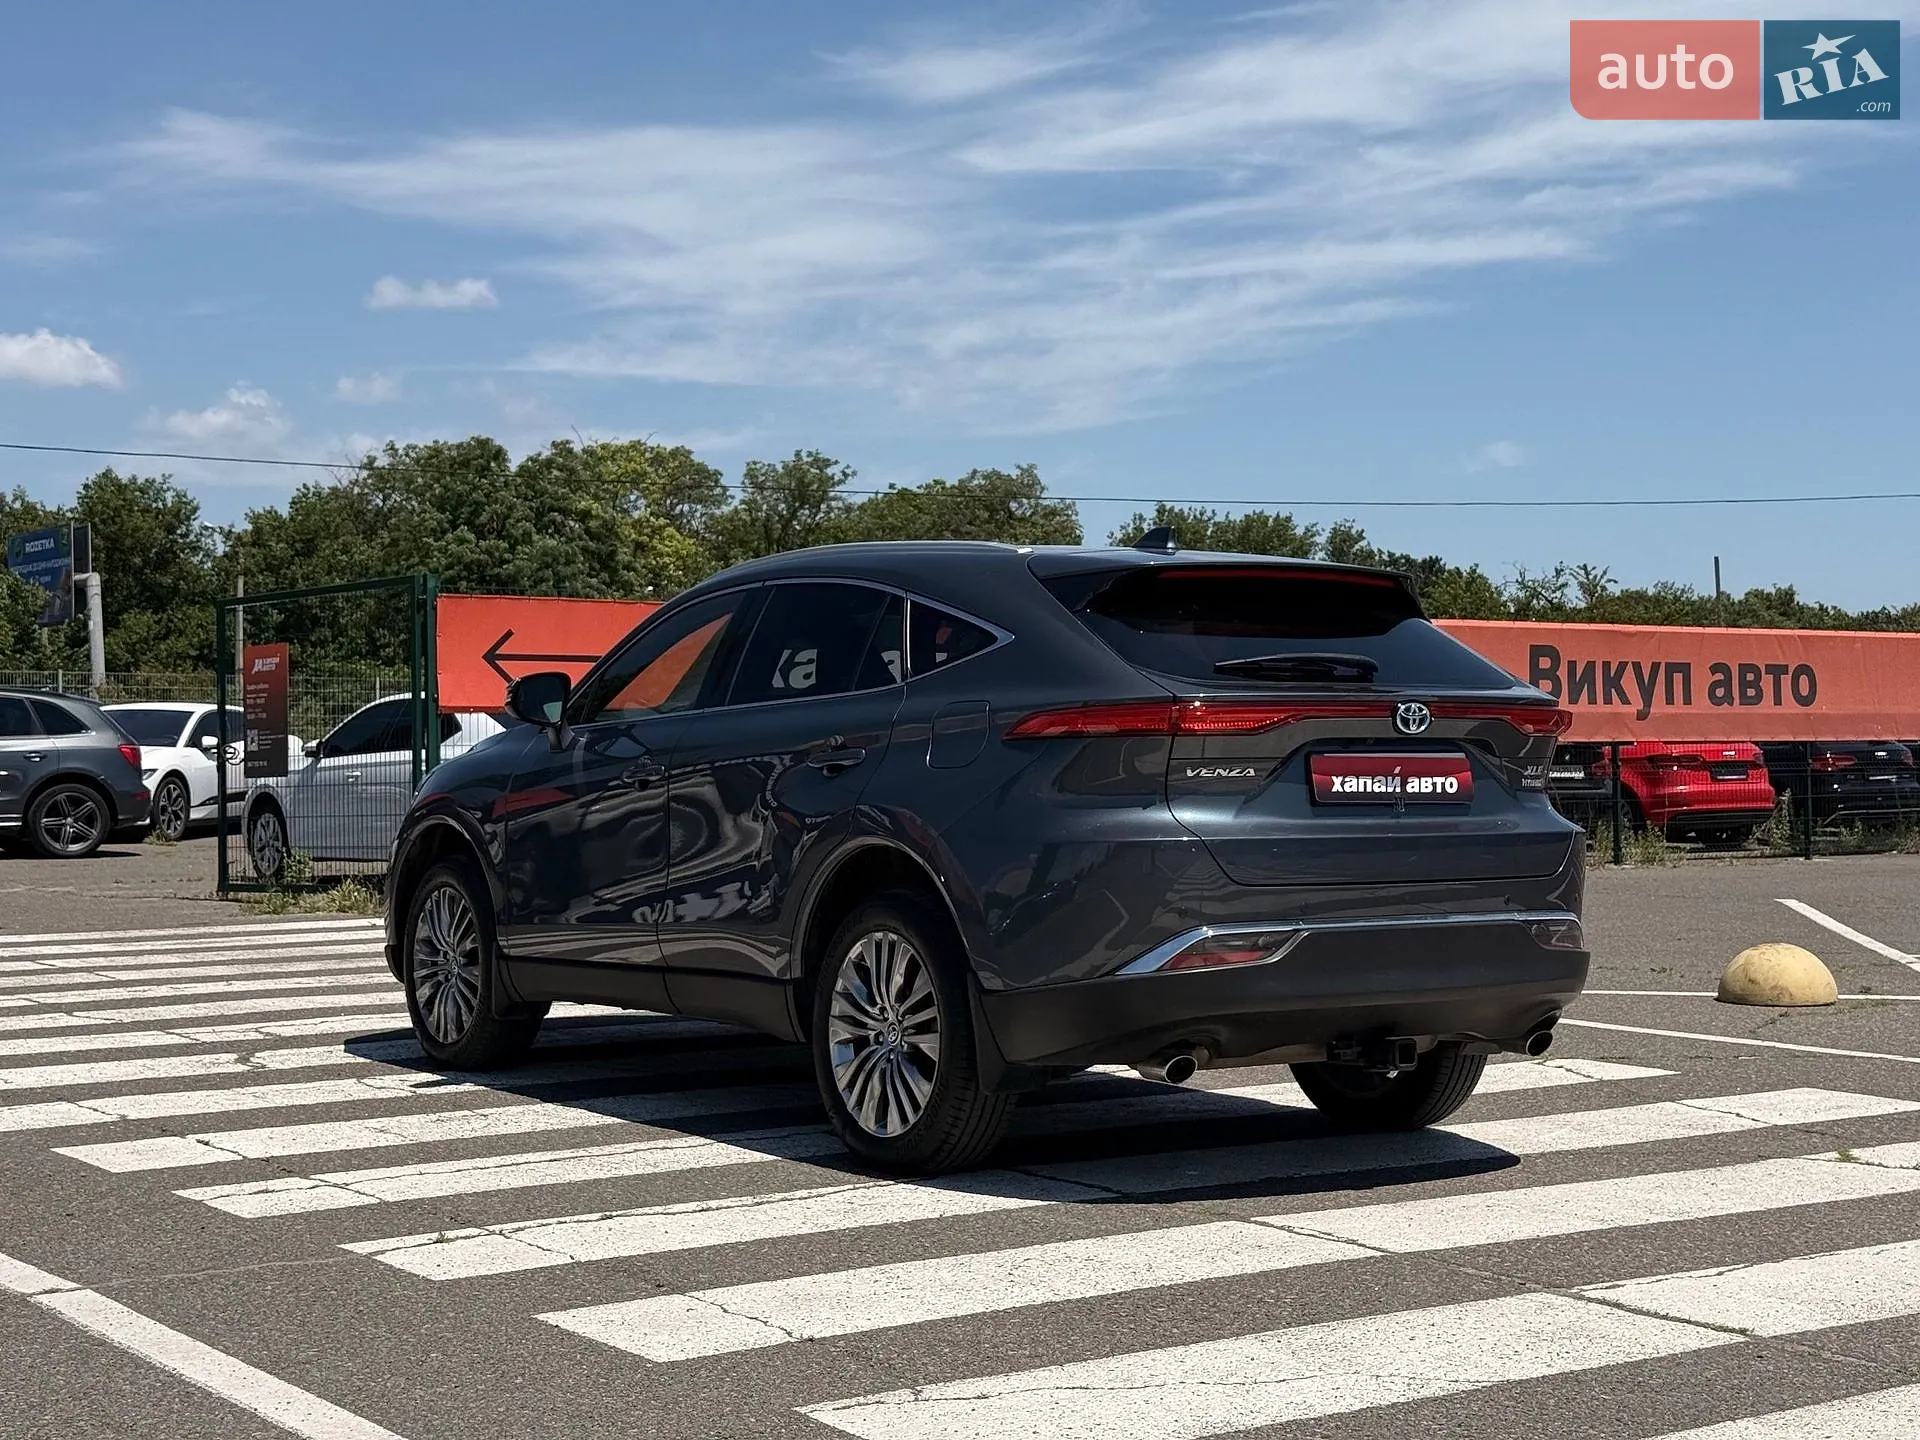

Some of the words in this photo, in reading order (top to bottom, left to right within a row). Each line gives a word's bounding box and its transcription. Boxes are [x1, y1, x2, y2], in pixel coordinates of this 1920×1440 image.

[25, 537, 55, 553] ROZETKA
[1529, 644, 1692, 721] Викуп
[1707, 662, 1818, 707] авто
[1185, 767, 1256, 777] VENZA
[1331, 766, 1401, 794] хапай
[1406, 777, 1459, 794] авто
